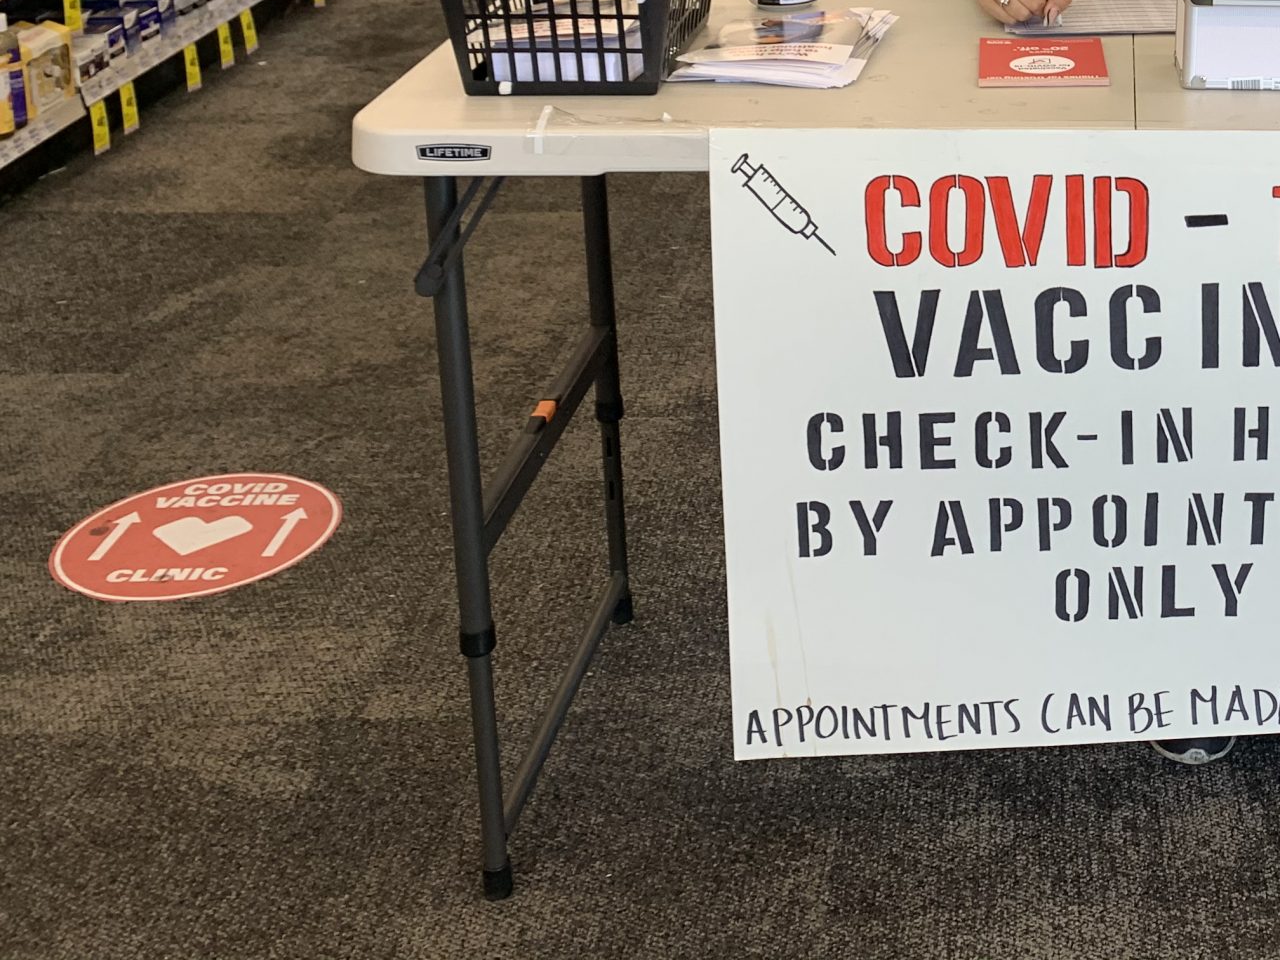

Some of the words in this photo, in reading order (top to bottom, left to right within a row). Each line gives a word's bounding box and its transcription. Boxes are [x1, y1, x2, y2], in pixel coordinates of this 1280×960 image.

[425, 148, 482, 157] LIFETIME
[863, 173, 1150, 270] COVID
[806, 407, 1194, 472] CHECK-IN
[155, 493, 300, 509] VACCINE
[184, 482, 288, 496] COVID
[795, 499, 895, 560] BY
[106, 567, 229, 583] CLINIC
[1054, 563, 1254, 623] ONLY
[745, 694, 1023, 747] APPOINTMENTS
[1041, 690, 1115, 734] CAN
[1128, 688, 1172, 733] BE
